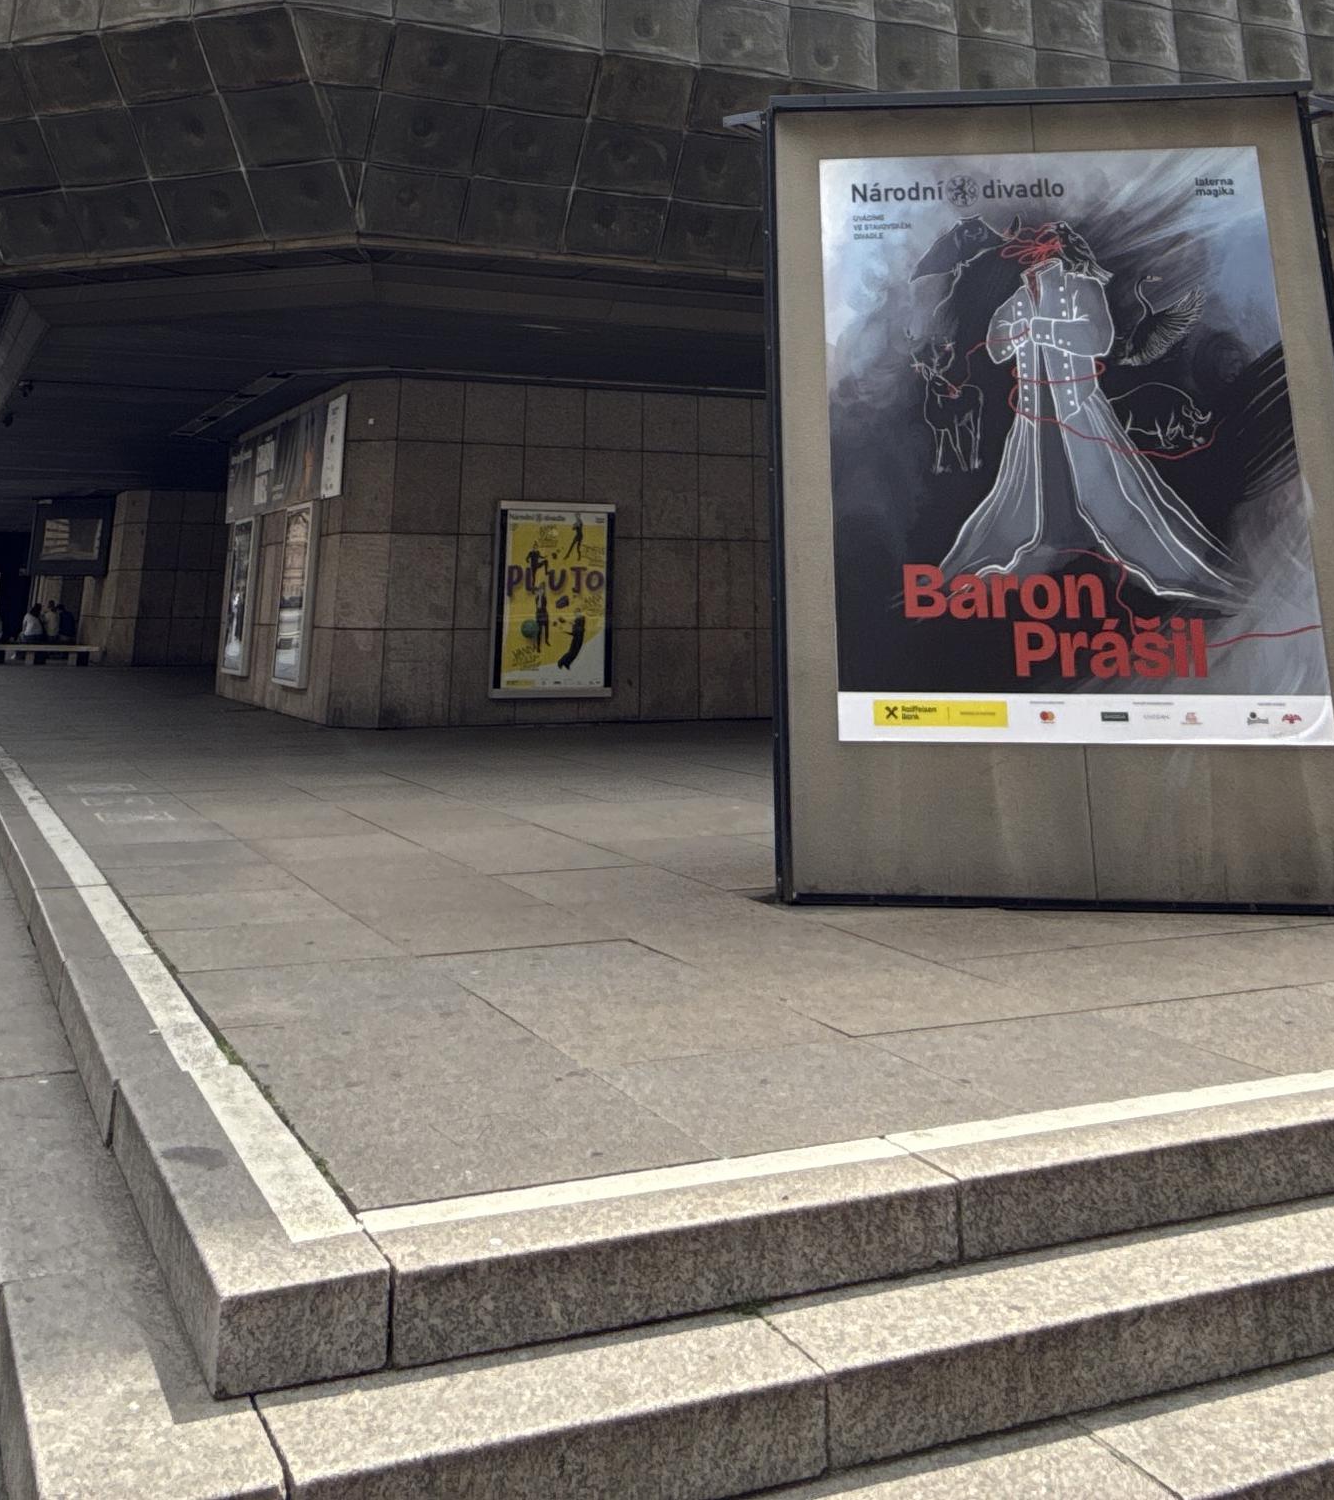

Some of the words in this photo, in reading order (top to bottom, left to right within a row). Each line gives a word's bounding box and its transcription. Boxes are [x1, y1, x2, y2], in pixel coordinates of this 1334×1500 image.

[851, 180, 944, 203] Národní
[982, 178, 1065, 200] divadlo
[1195, 177, 1234, 187] laterna
[1195, 187, 1235, 198] magika
[506, 565, 605, 597] PLUTO
[902, 563, 1105, 619] Baron
[1013, 616, 1208, 679] Prášil
